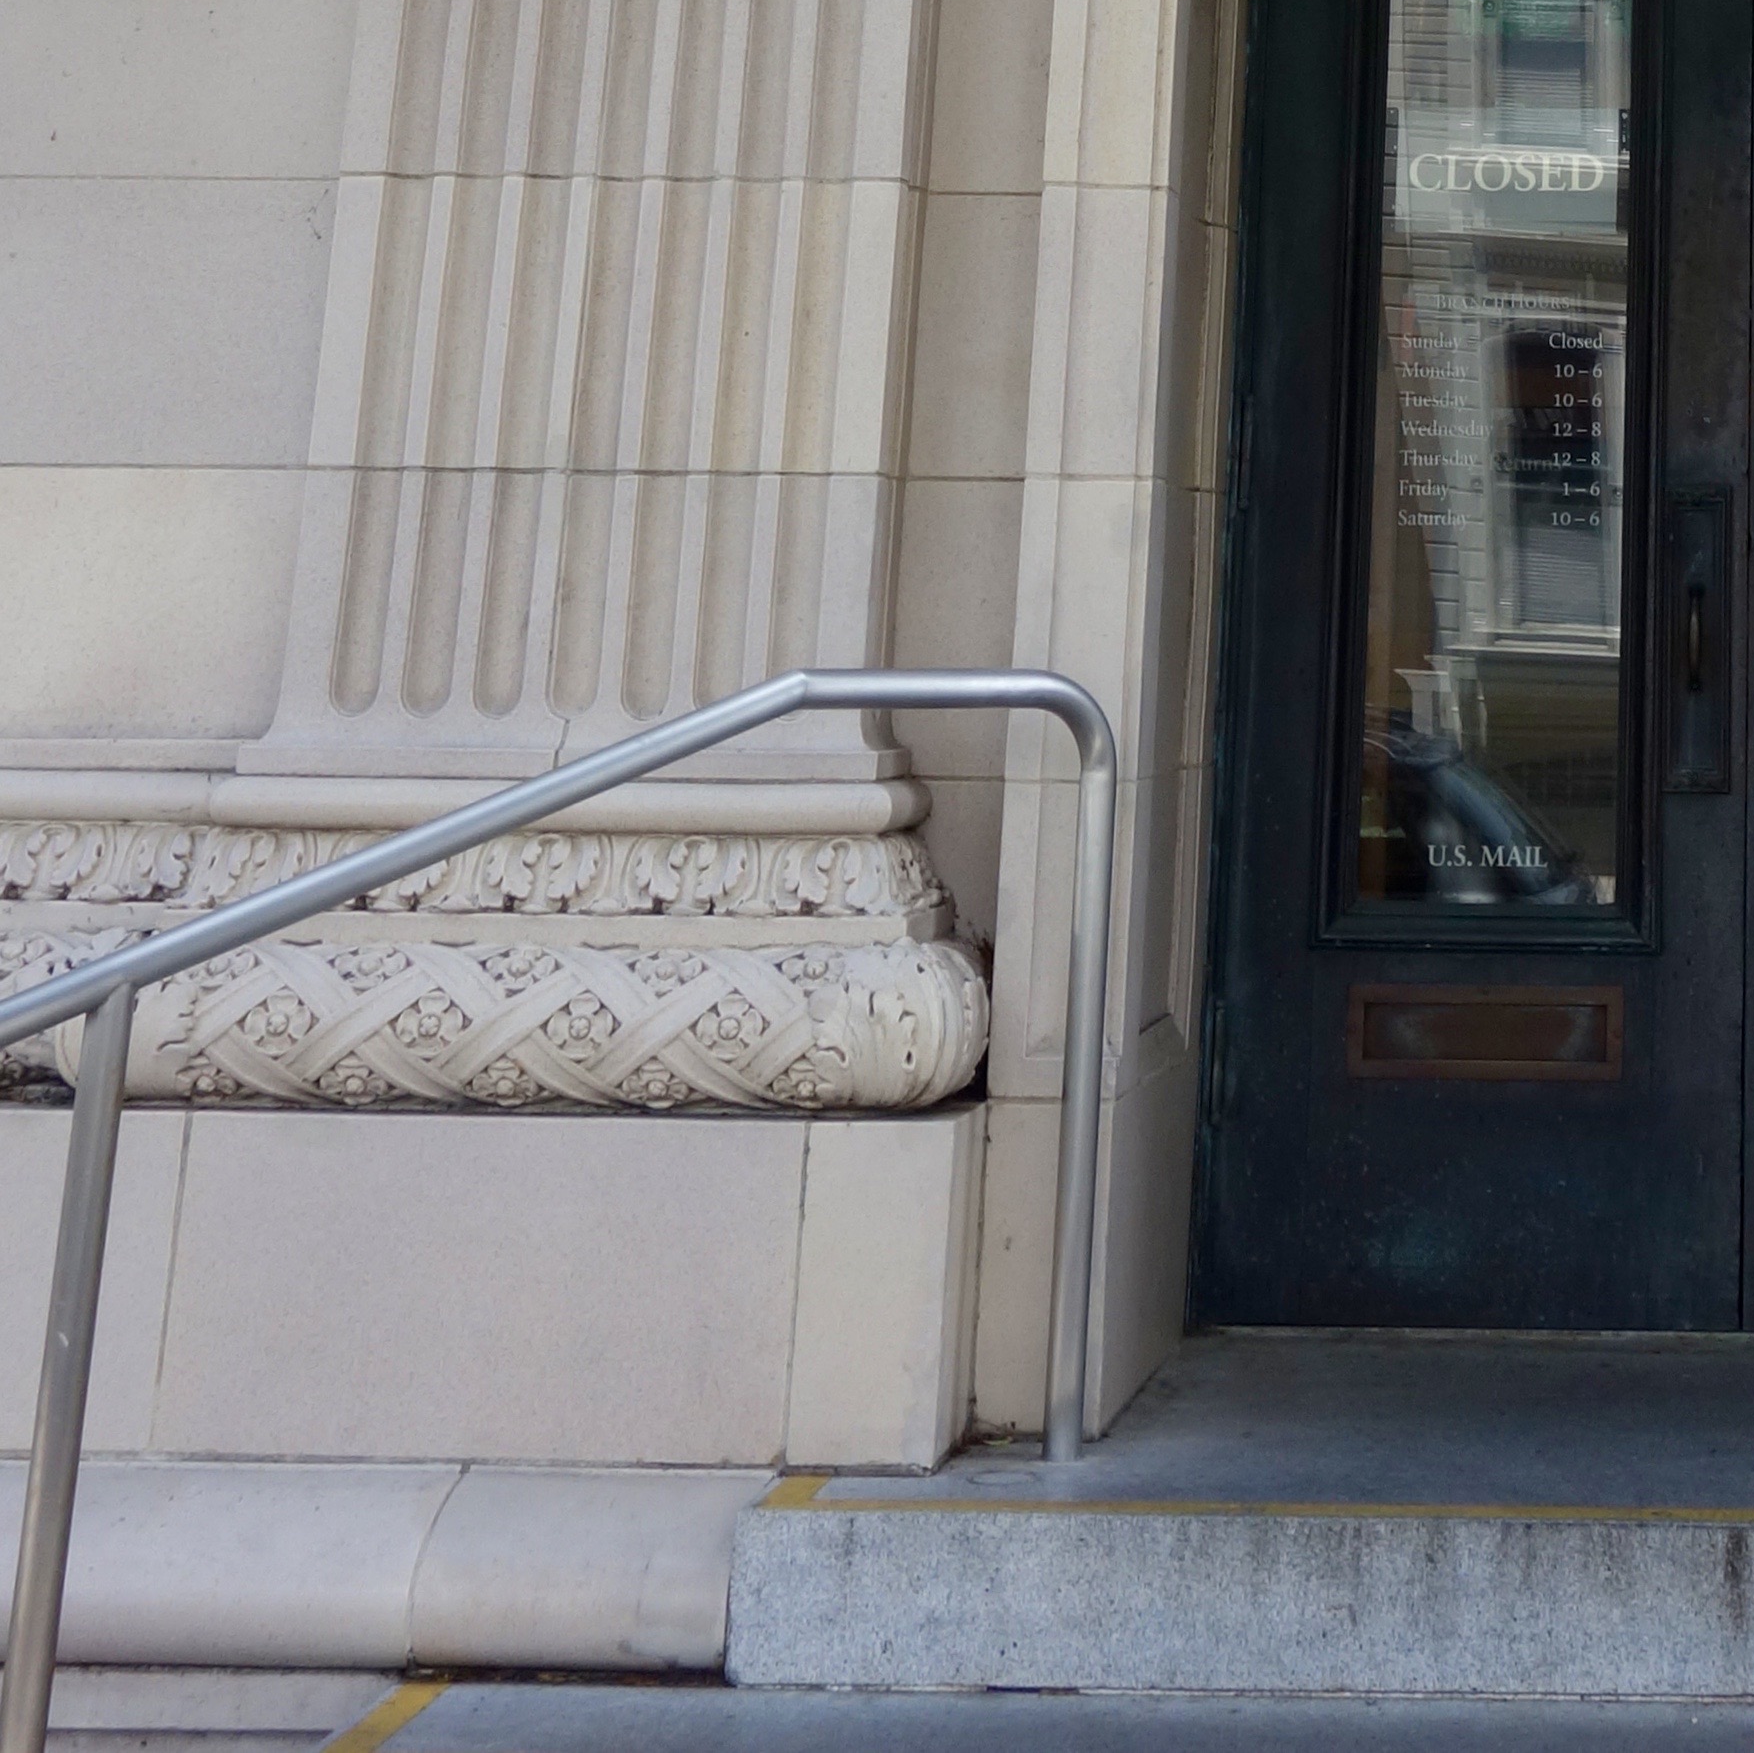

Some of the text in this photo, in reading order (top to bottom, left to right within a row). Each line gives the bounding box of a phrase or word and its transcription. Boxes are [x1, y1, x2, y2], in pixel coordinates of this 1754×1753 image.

[1409, 153, 1604, 192] CLOSED
[1403, 331, 1603, 351] Sunday Closed
[1401, 361, 1469, 381] Monday
[1400, 391, 1468, 411] Tuesday
[1401, 420, 1493, 440] Wednesday
[1400, 449, 1477, 470] Thursday
[1399, 478, 1449, 500] Friday
[1398, 509, 1468, 529] Saturday
[1427, 844, 1548, 868] U.S. MAIL
